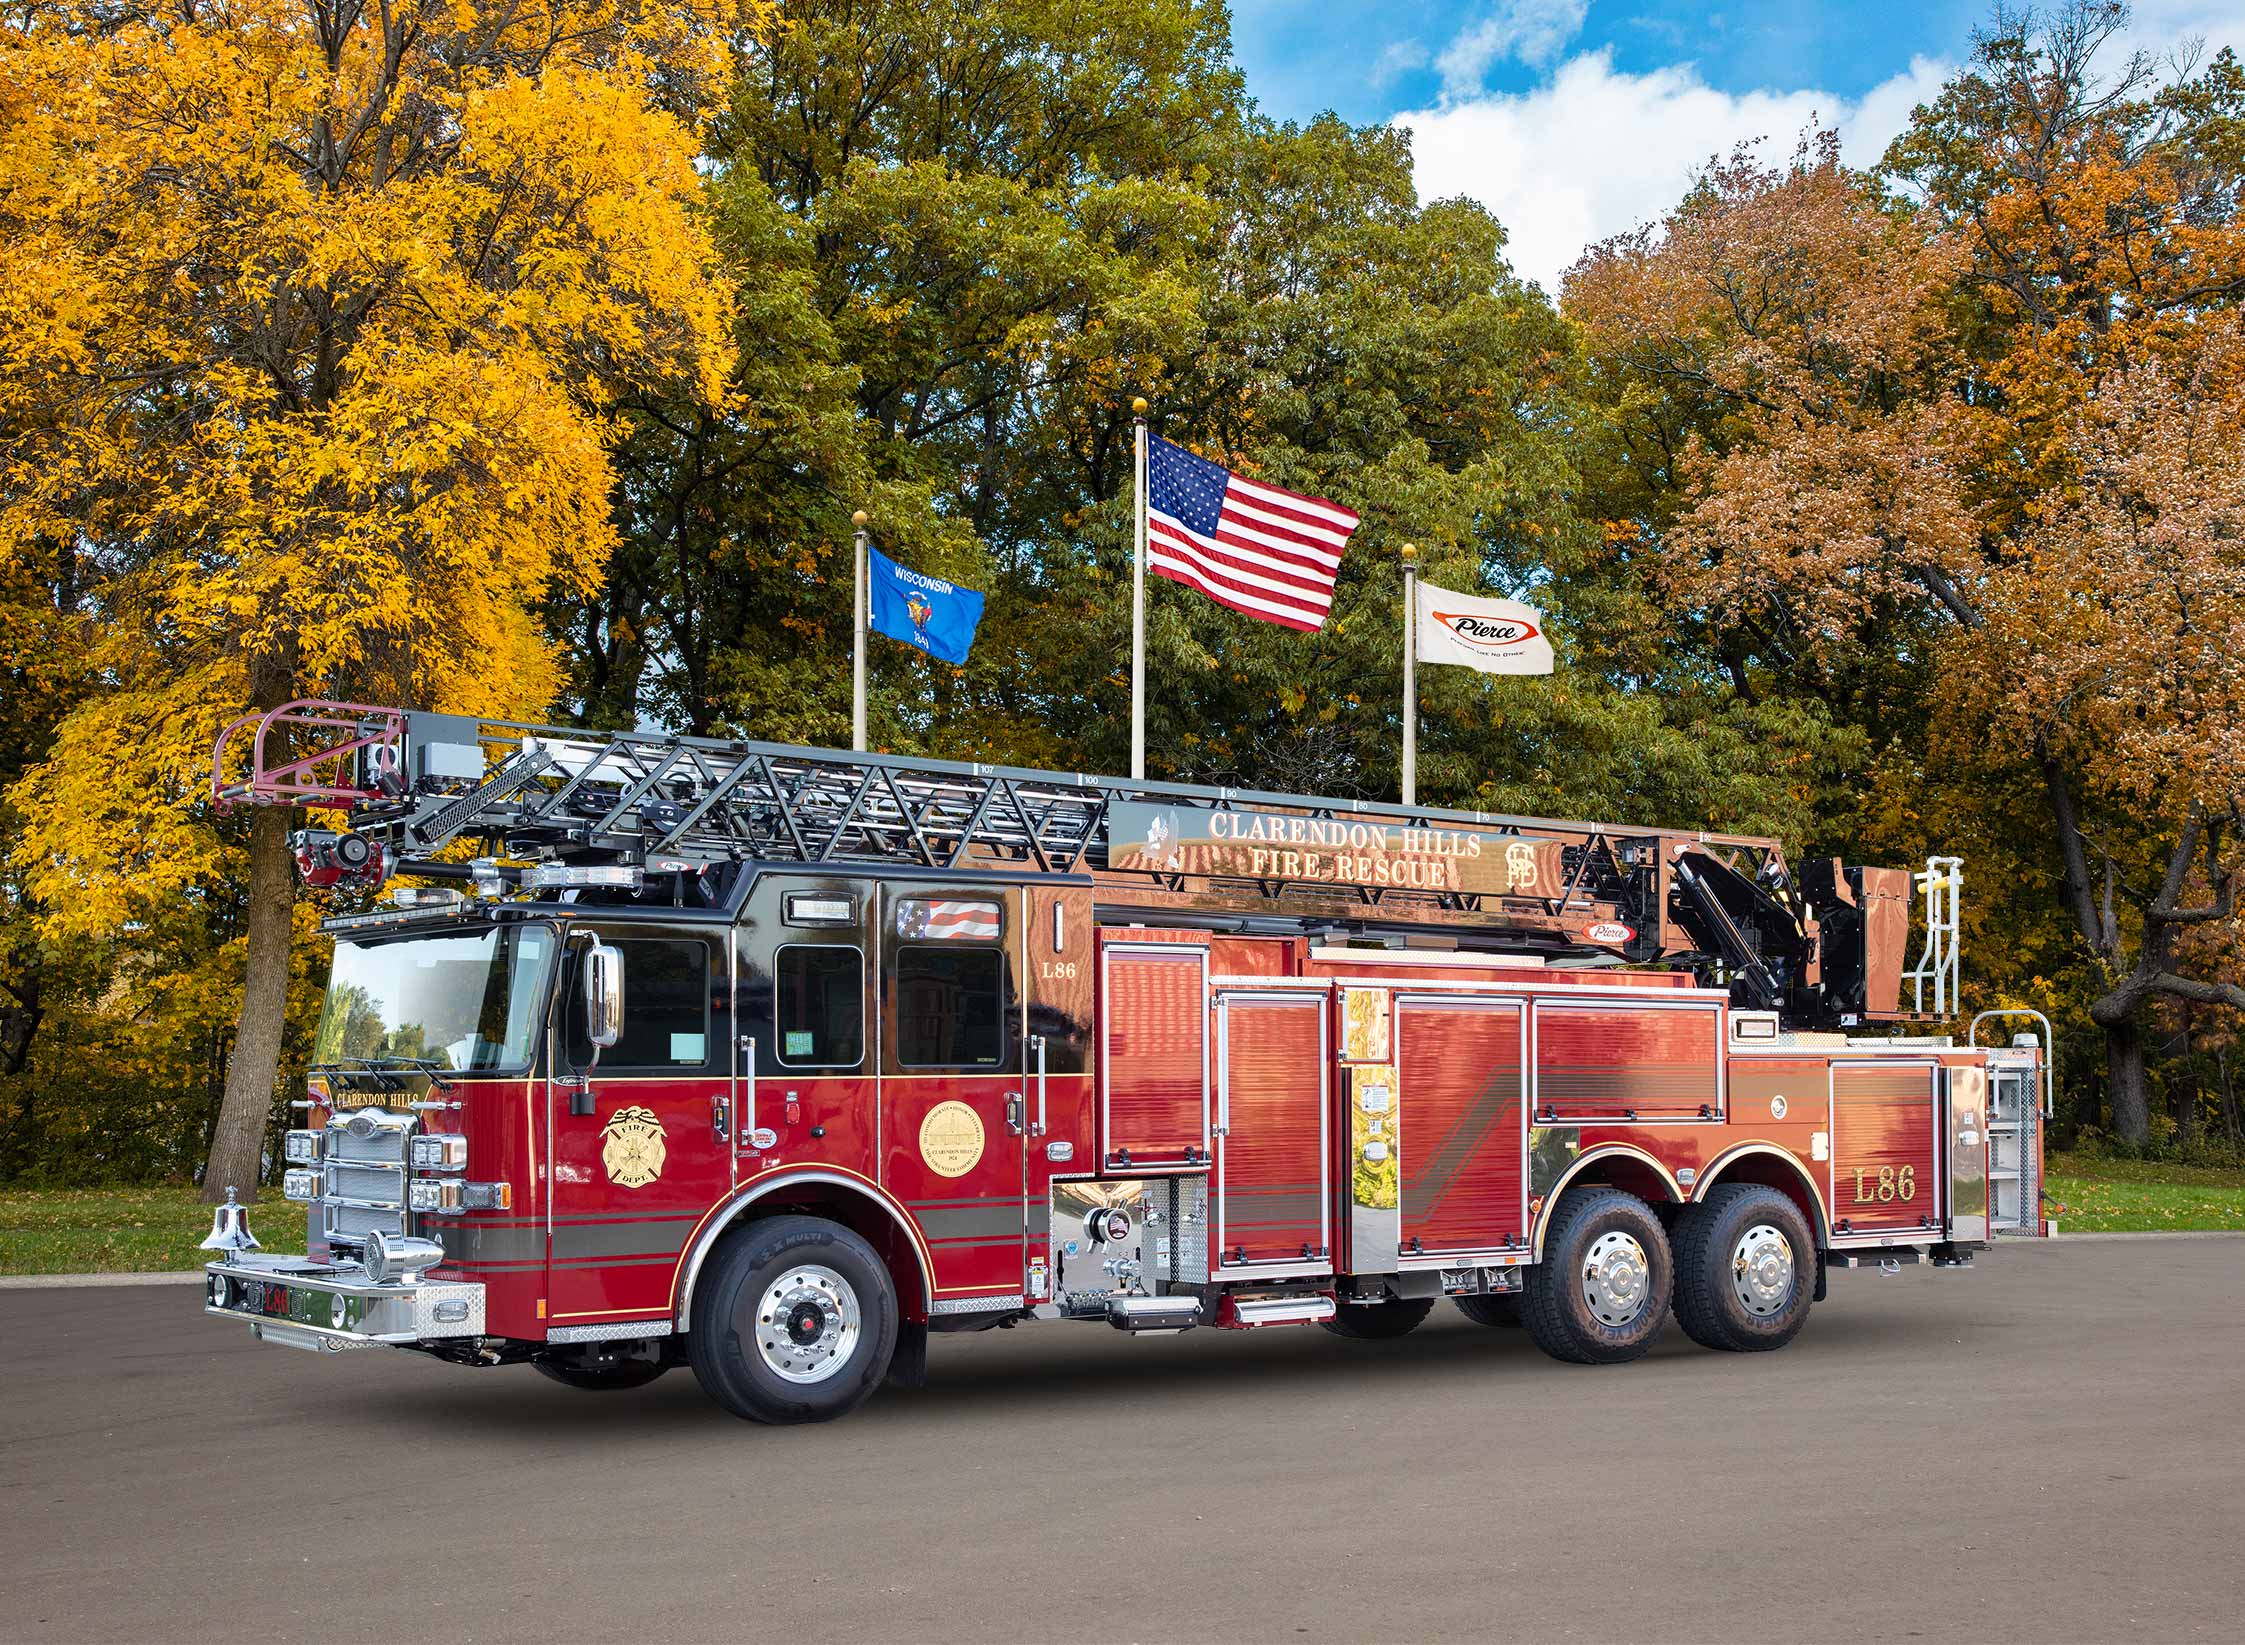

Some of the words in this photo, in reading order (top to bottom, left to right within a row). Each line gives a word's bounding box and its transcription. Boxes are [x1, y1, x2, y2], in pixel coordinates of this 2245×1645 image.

[895, 566, 953, 595] WISCONSIN
[1455, 617, 1518, 639] Pierce
[981, 765, 995, 775] 107
[1084, 776, 1099, 785] 100
[1226, 789, 1237, 798] 90
[1358, 802, 1368, 810] 80
[1209, 812, 1388, 850] CLARENDON
[1401, 828, 1481, 858] HILLS
[1251, 848, 1320, 881] FIRE
[1334, 855, 1446, 888] RESCUE
[1594, 925, 1626, 939] Pierce
[1041, 961, 1076, 979] L86
[337, 1093, 387, 1108] CLARENDON
[622, 1125, 648, 1134] FIRE
[1852, 1165, 1916, 1203] L86
[786, 1232, 821, 1244] MULTI
[265, 1285, 289, 1314] L86
